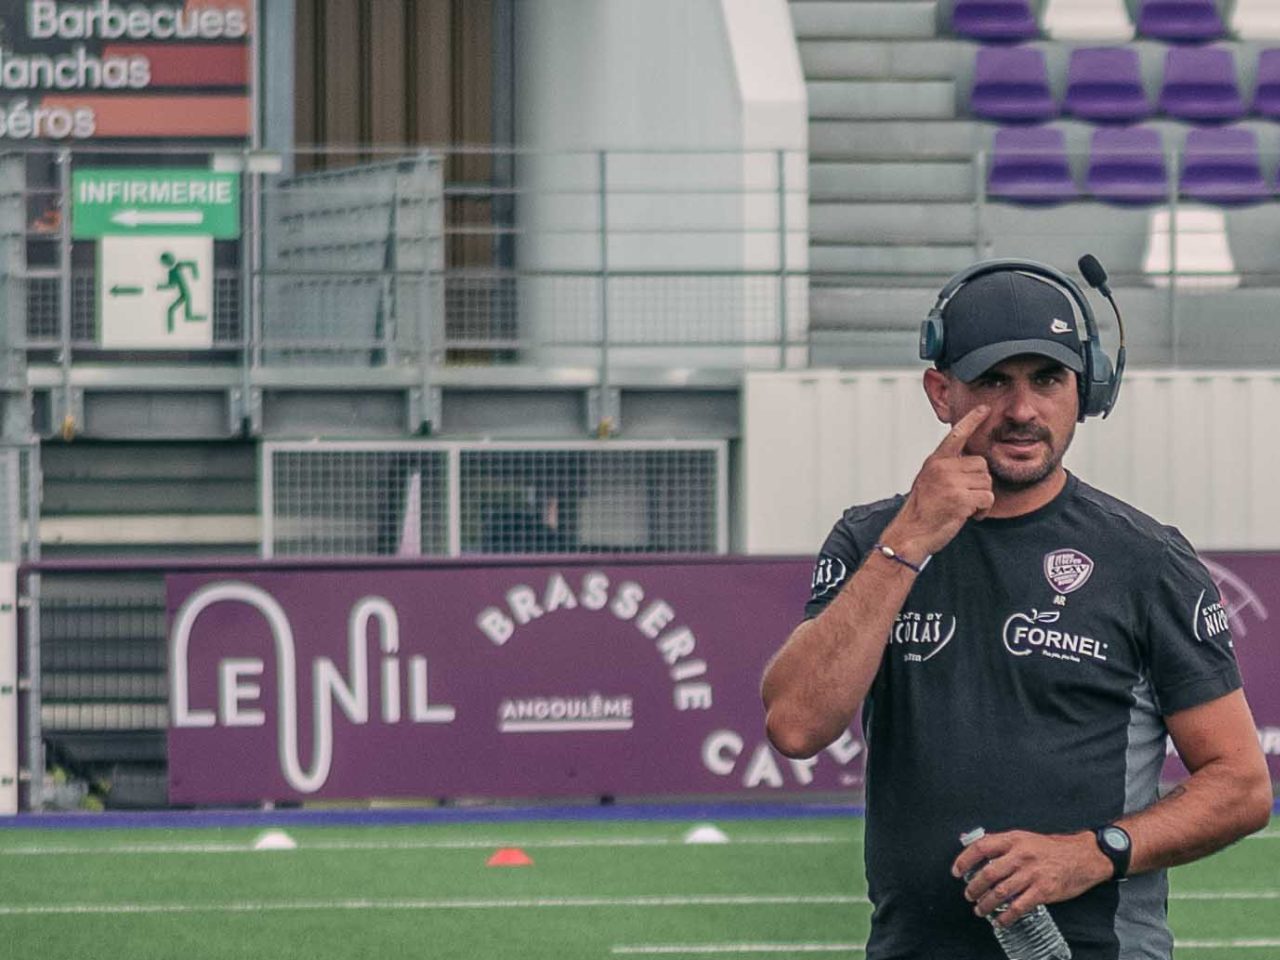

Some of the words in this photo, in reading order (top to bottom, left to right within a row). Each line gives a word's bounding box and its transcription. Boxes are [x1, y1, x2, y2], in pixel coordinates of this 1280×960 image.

[31, 0, 247, 39] Barbecues
[79, 180, 234, 205] INFIRMERIE
[476, 570, 714, 712] BRASSERIE
[1014, 626, 1107, 661] FORNEL
[501, 692, 634, 720] ANGOULÊME
